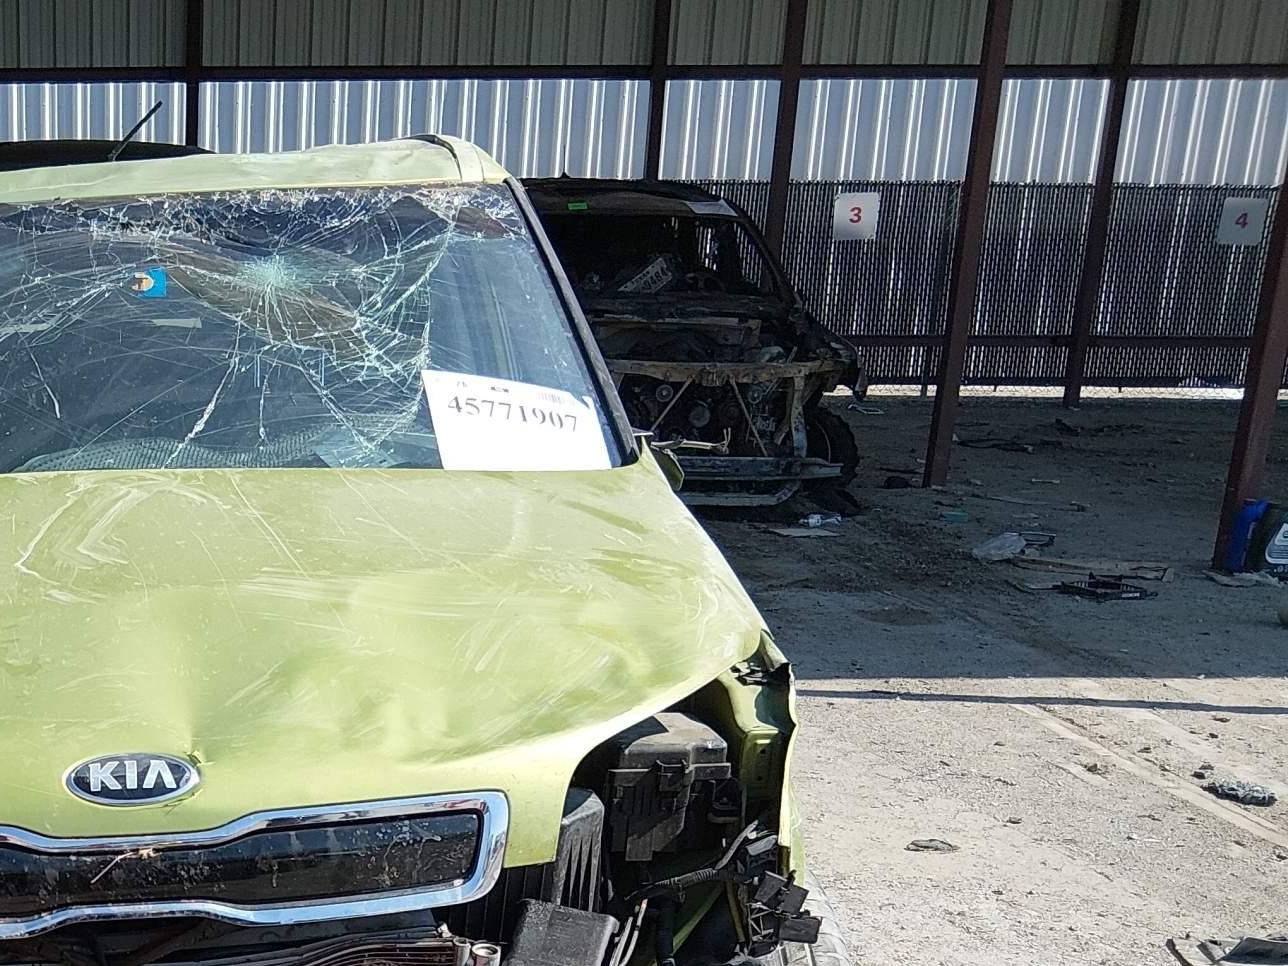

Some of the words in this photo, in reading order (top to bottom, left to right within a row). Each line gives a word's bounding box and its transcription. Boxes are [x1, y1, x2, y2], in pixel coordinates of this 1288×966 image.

[848, 206, 863, 224] 3
[1234, 212, 1249, 229] 4
[448, 396, 577, 432] 45771907
[87, 759, 178, 792] KIA
